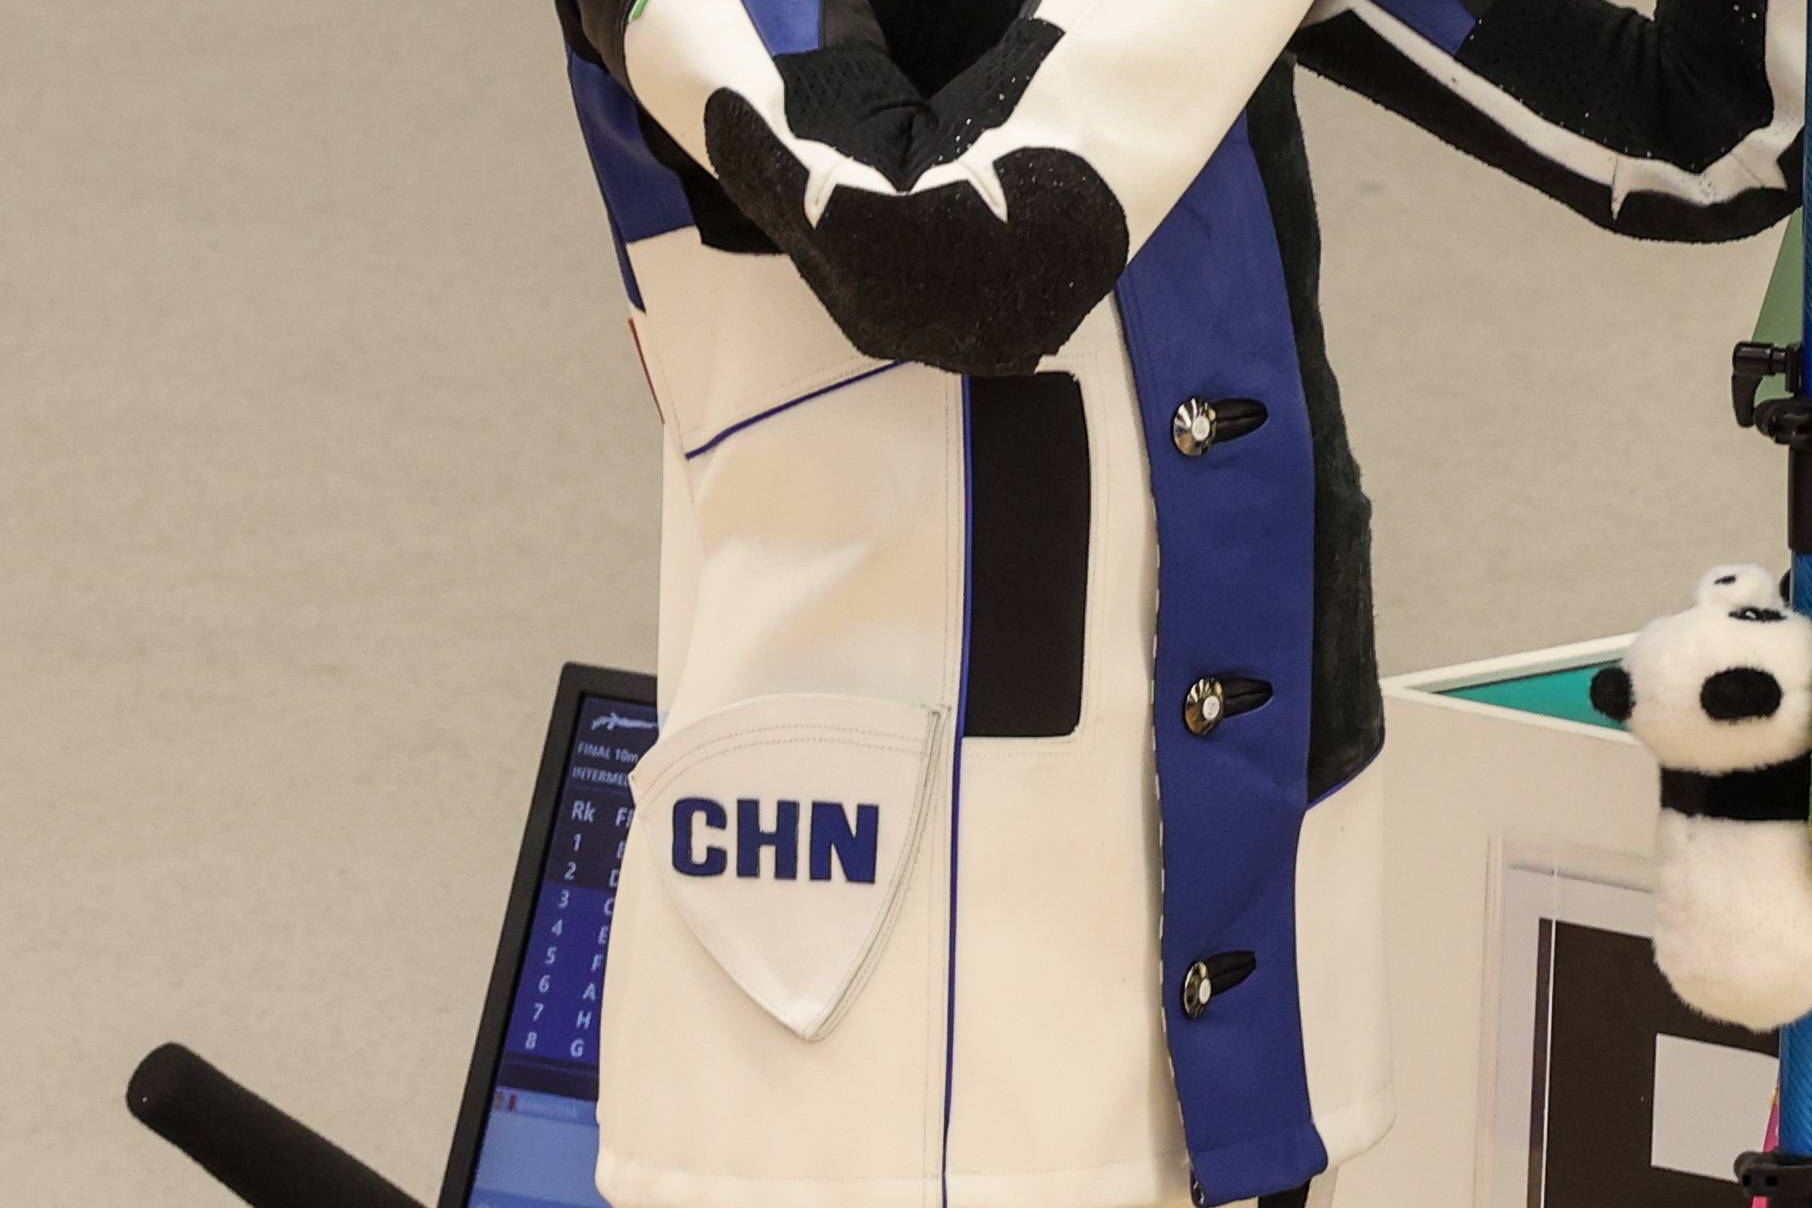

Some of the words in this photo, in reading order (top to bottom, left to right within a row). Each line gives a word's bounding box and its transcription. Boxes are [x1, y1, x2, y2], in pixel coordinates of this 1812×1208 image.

[578, 742, 610, 760] FINAL
[571, 800, 596, 823] Rk
[573, 833, 582, 851] 1
[672, 796, 879, 884] CHN
[564, 861, 577, 880] 2
[558, 889, 570, 909] 3
[551, 919, 563, 937] 4
[598, 925, 609, 945] E
[545, 946, 557, 965] 5
[591, 954, 603, 972] F
[538, 974, 551, 993] 6
[582, 983, 596, 1001] A
[533, 1002, 545, 1022] 7
[576, 1010, 592, 1029] H
[525, 1031, 538, 1050] 8
[570, 1038, 585, 1058] G
